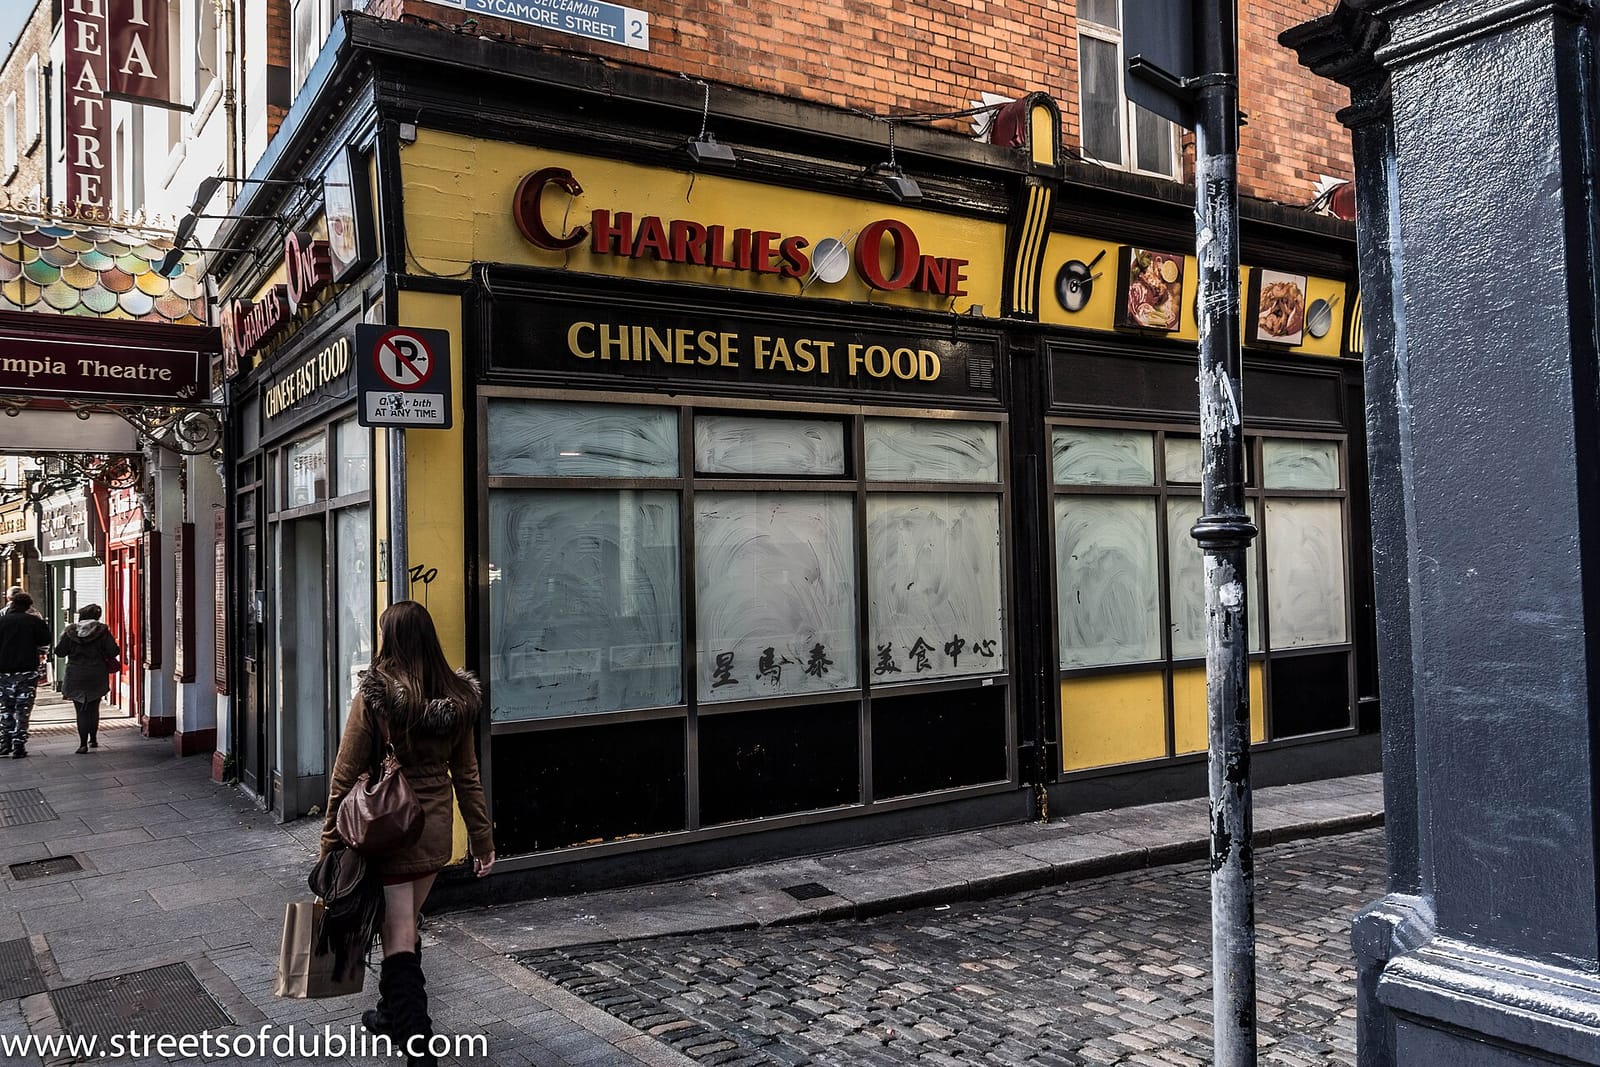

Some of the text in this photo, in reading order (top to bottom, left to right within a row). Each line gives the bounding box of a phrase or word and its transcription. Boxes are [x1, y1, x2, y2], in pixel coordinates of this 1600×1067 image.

[476, 0, 617, 38] SYCAMORE STREET
[630, 20, 643, 39] 2
[513, 166, 969, 297] CHARLIES ONE
[284, 231, 320, 305] ONE
[0, 356, 173, 382] mpia Theatre
[567, 321, 942, 382] CHINESE FAST FOOD
[265, 337, 349, 419] CHINESE FAST FOOD
[375, 408, 437, 419] AT ANY TIME
